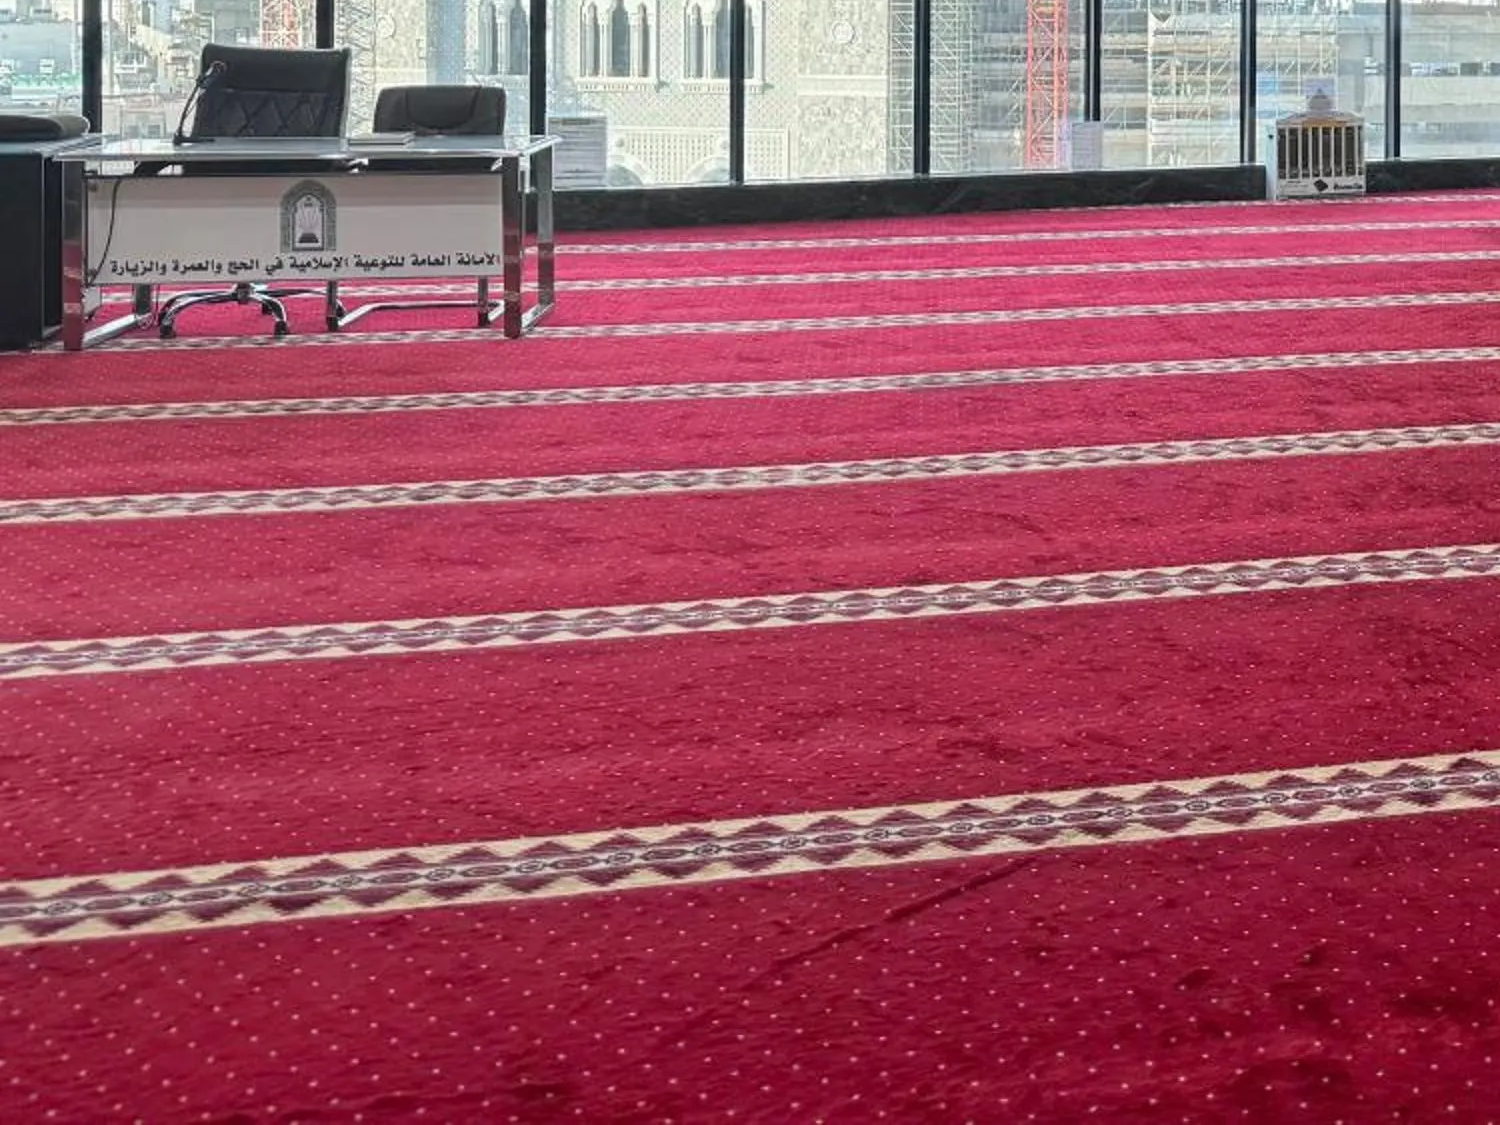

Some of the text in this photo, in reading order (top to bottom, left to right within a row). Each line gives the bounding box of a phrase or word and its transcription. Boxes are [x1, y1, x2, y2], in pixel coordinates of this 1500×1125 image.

[110, 259, 167, 276] والزيارة
[171, 258, 223, 275] والعمرة
[227, 258, 260, 275] الحج
[265, 256, 284, 275] في
[289, 254, 349, 272] الإسلامية
[353, 253, 405, 271] للتوعية
[410, 253, 451, 267] العامة
